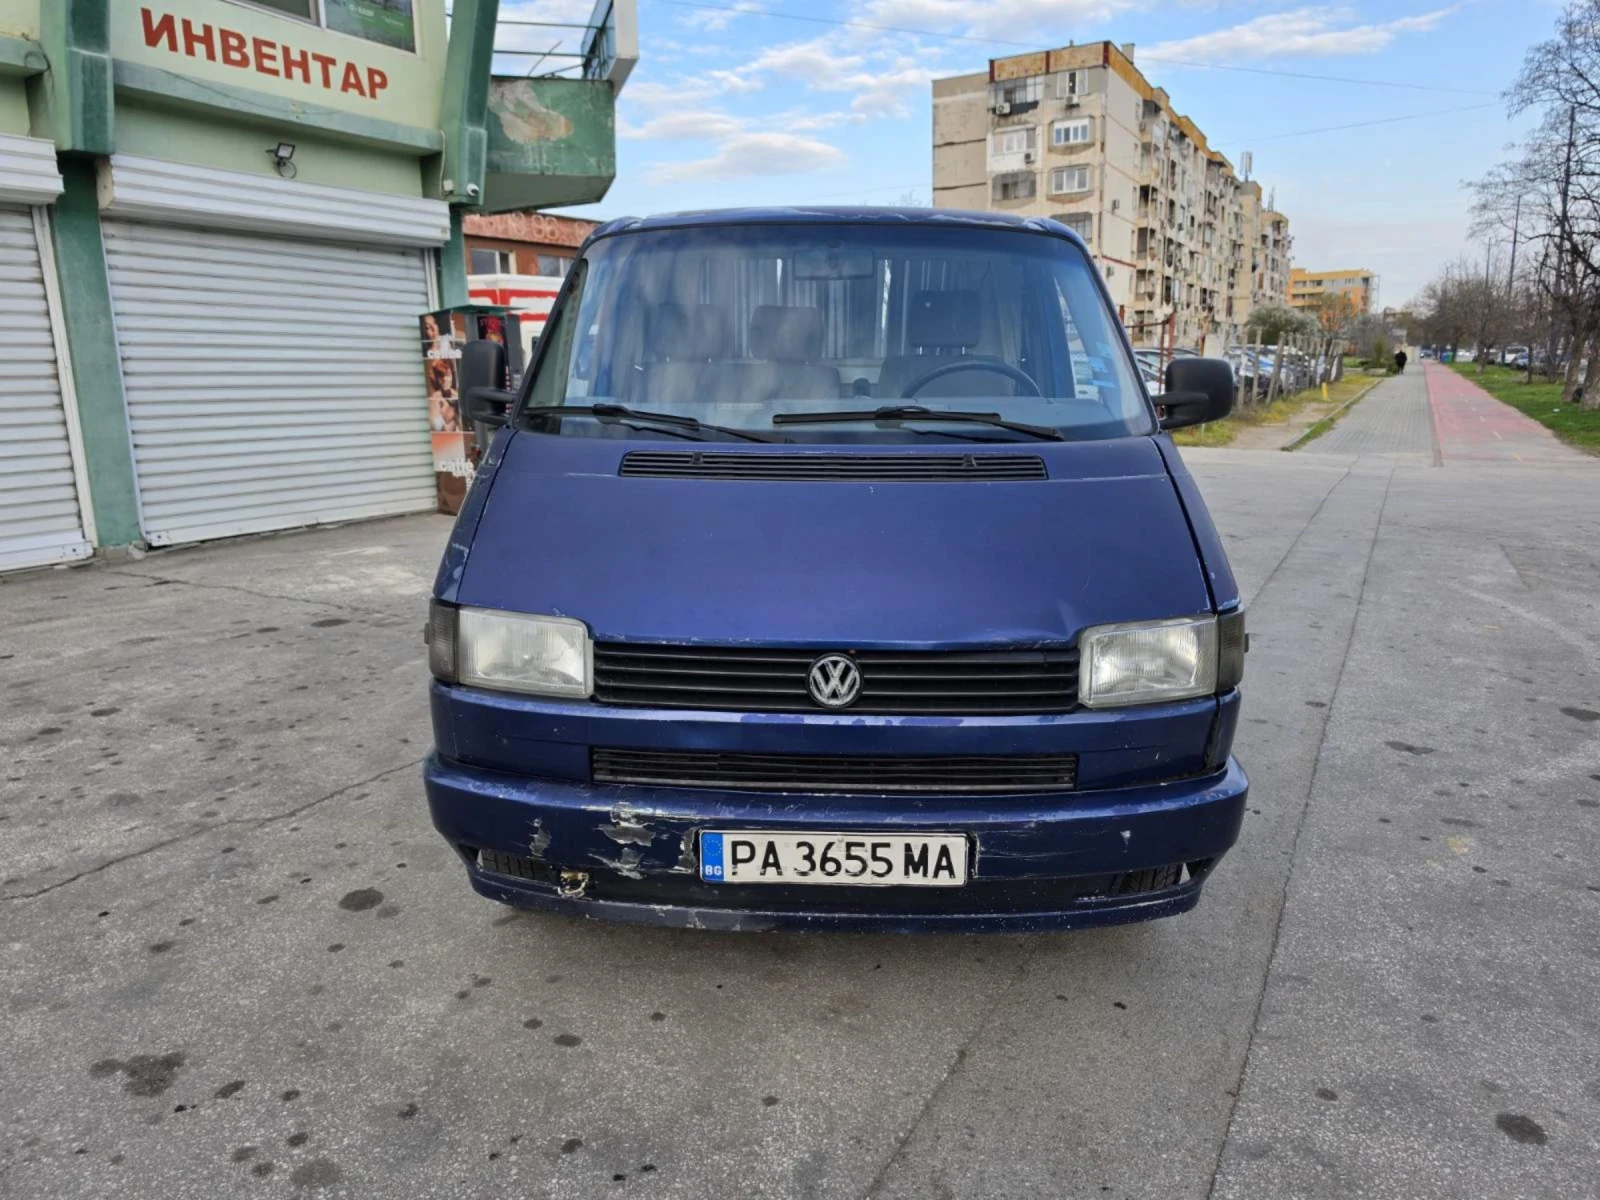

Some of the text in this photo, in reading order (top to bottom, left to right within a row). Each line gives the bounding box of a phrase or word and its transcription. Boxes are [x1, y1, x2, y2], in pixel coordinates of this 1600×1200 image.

[140, 7, 389, 100] ИНВЕНТАР
[705, 865, 722, 876] BG
[731, 840, 956, 879] PA 3655 MA
